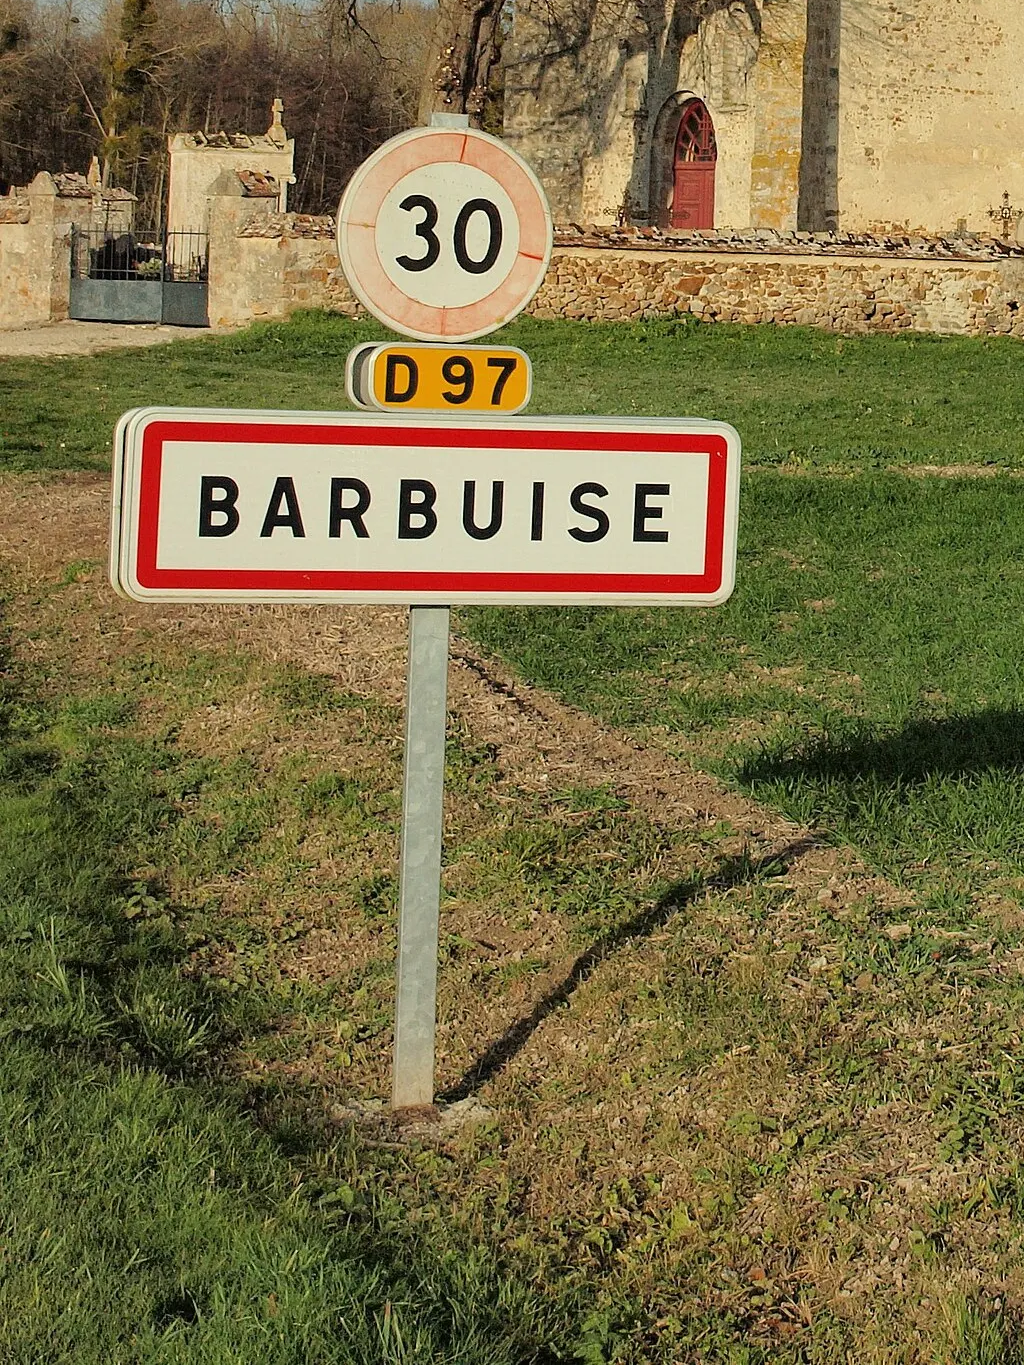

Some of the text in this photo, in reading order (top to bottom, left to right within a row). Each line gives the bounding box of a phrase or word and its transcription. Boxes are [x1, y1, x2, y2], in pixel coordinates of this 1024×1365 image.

[395, 194, 503, 275] 30
[384, 354, 518, 406] D 97
[198, 475, 670, 544] BARBUISE
